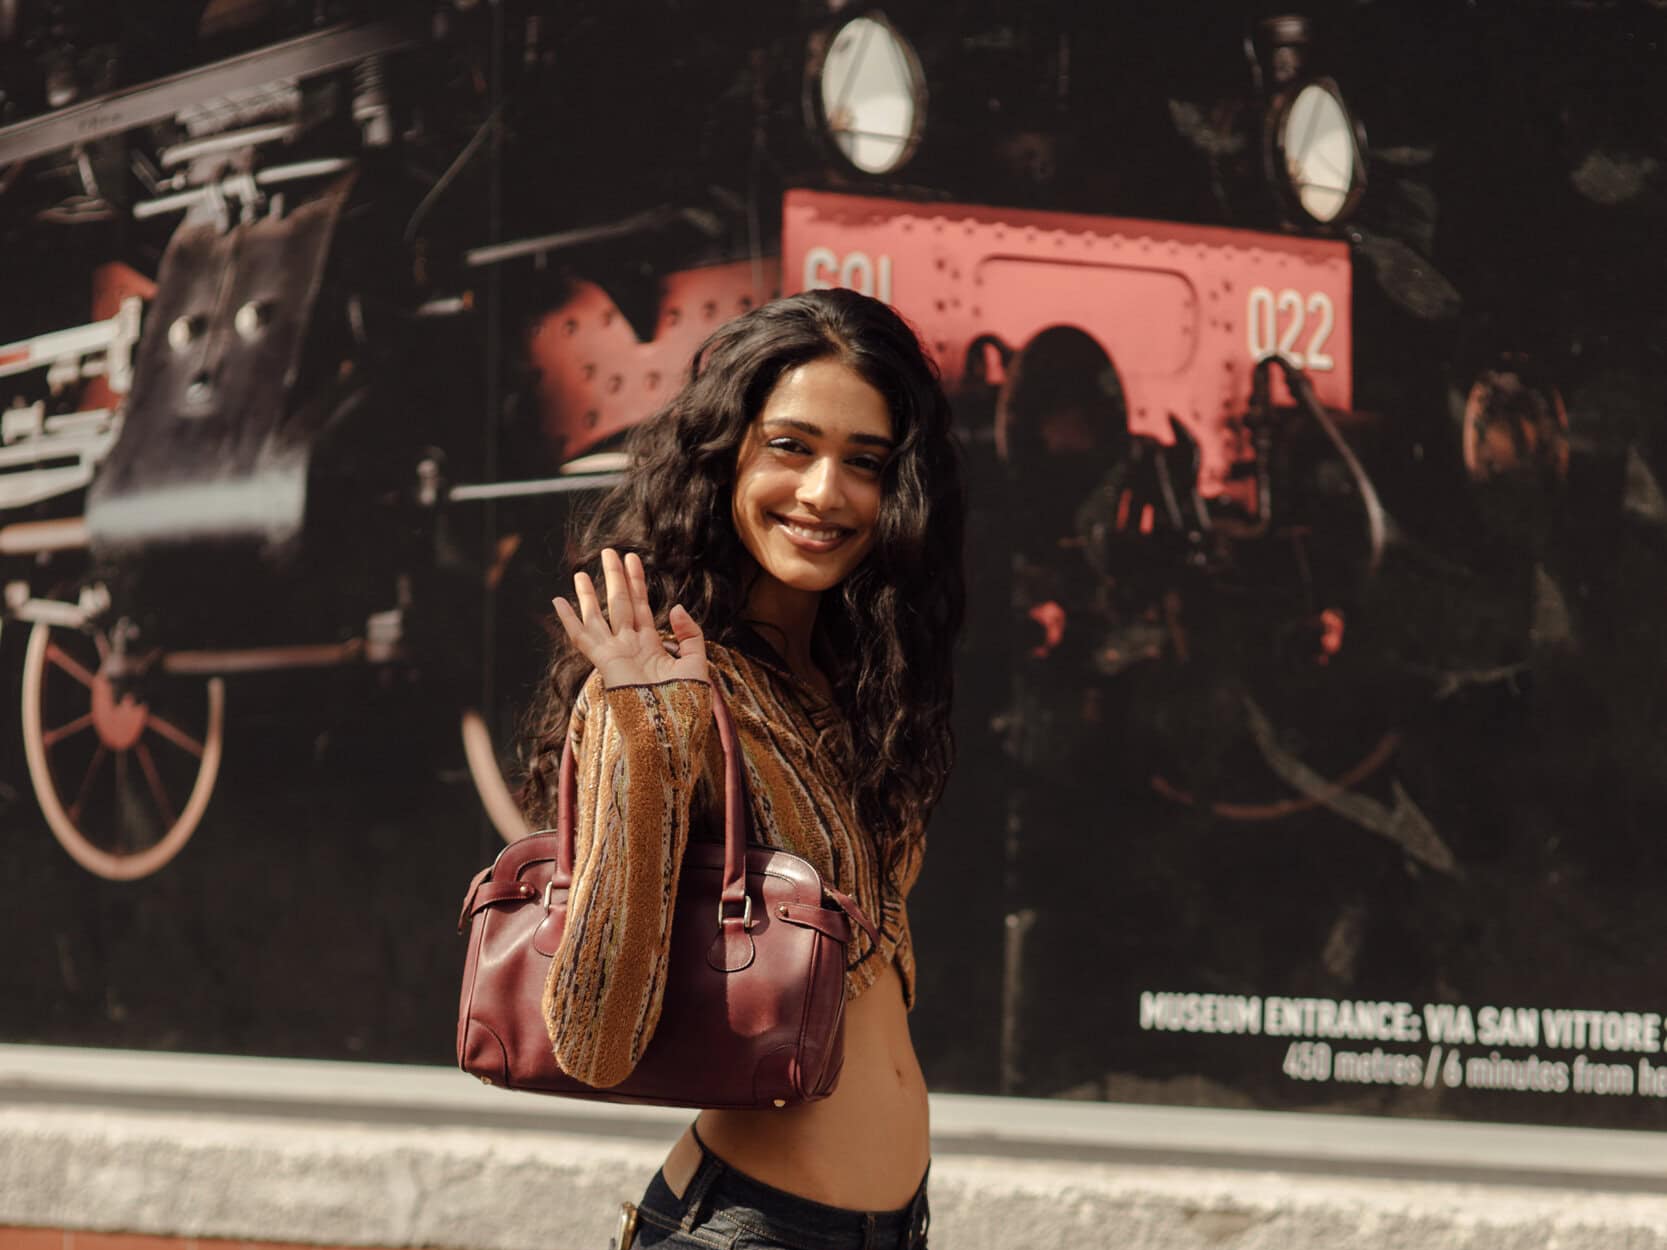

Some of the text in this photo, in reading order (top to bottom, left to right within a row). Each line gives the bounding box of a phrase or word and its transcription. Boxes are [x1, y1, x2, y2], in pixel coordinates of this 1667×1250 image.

[1248, 286, 1335, 369] 022
[1140, 991, 1261, 1034] MUSEUM
[1264, 996, 1422, 1042] ENTRANCE:
[1423, 1003, 1476, 1044] VIA
[1477, 1005, 1540, 1047] SAN
[1541, 1008, 1661, 1053] VITTORE
[1283, 1041, 1332, 1081] 450
[1334, 1048, 1422, 1085] metres
[1423, 1045, 1442, 1089] /
[1442, 1049, 1463, 1087] 6
[1465, 1051, 1569, 1093] minutes
[1573, 1054, 1634, 1096] from
